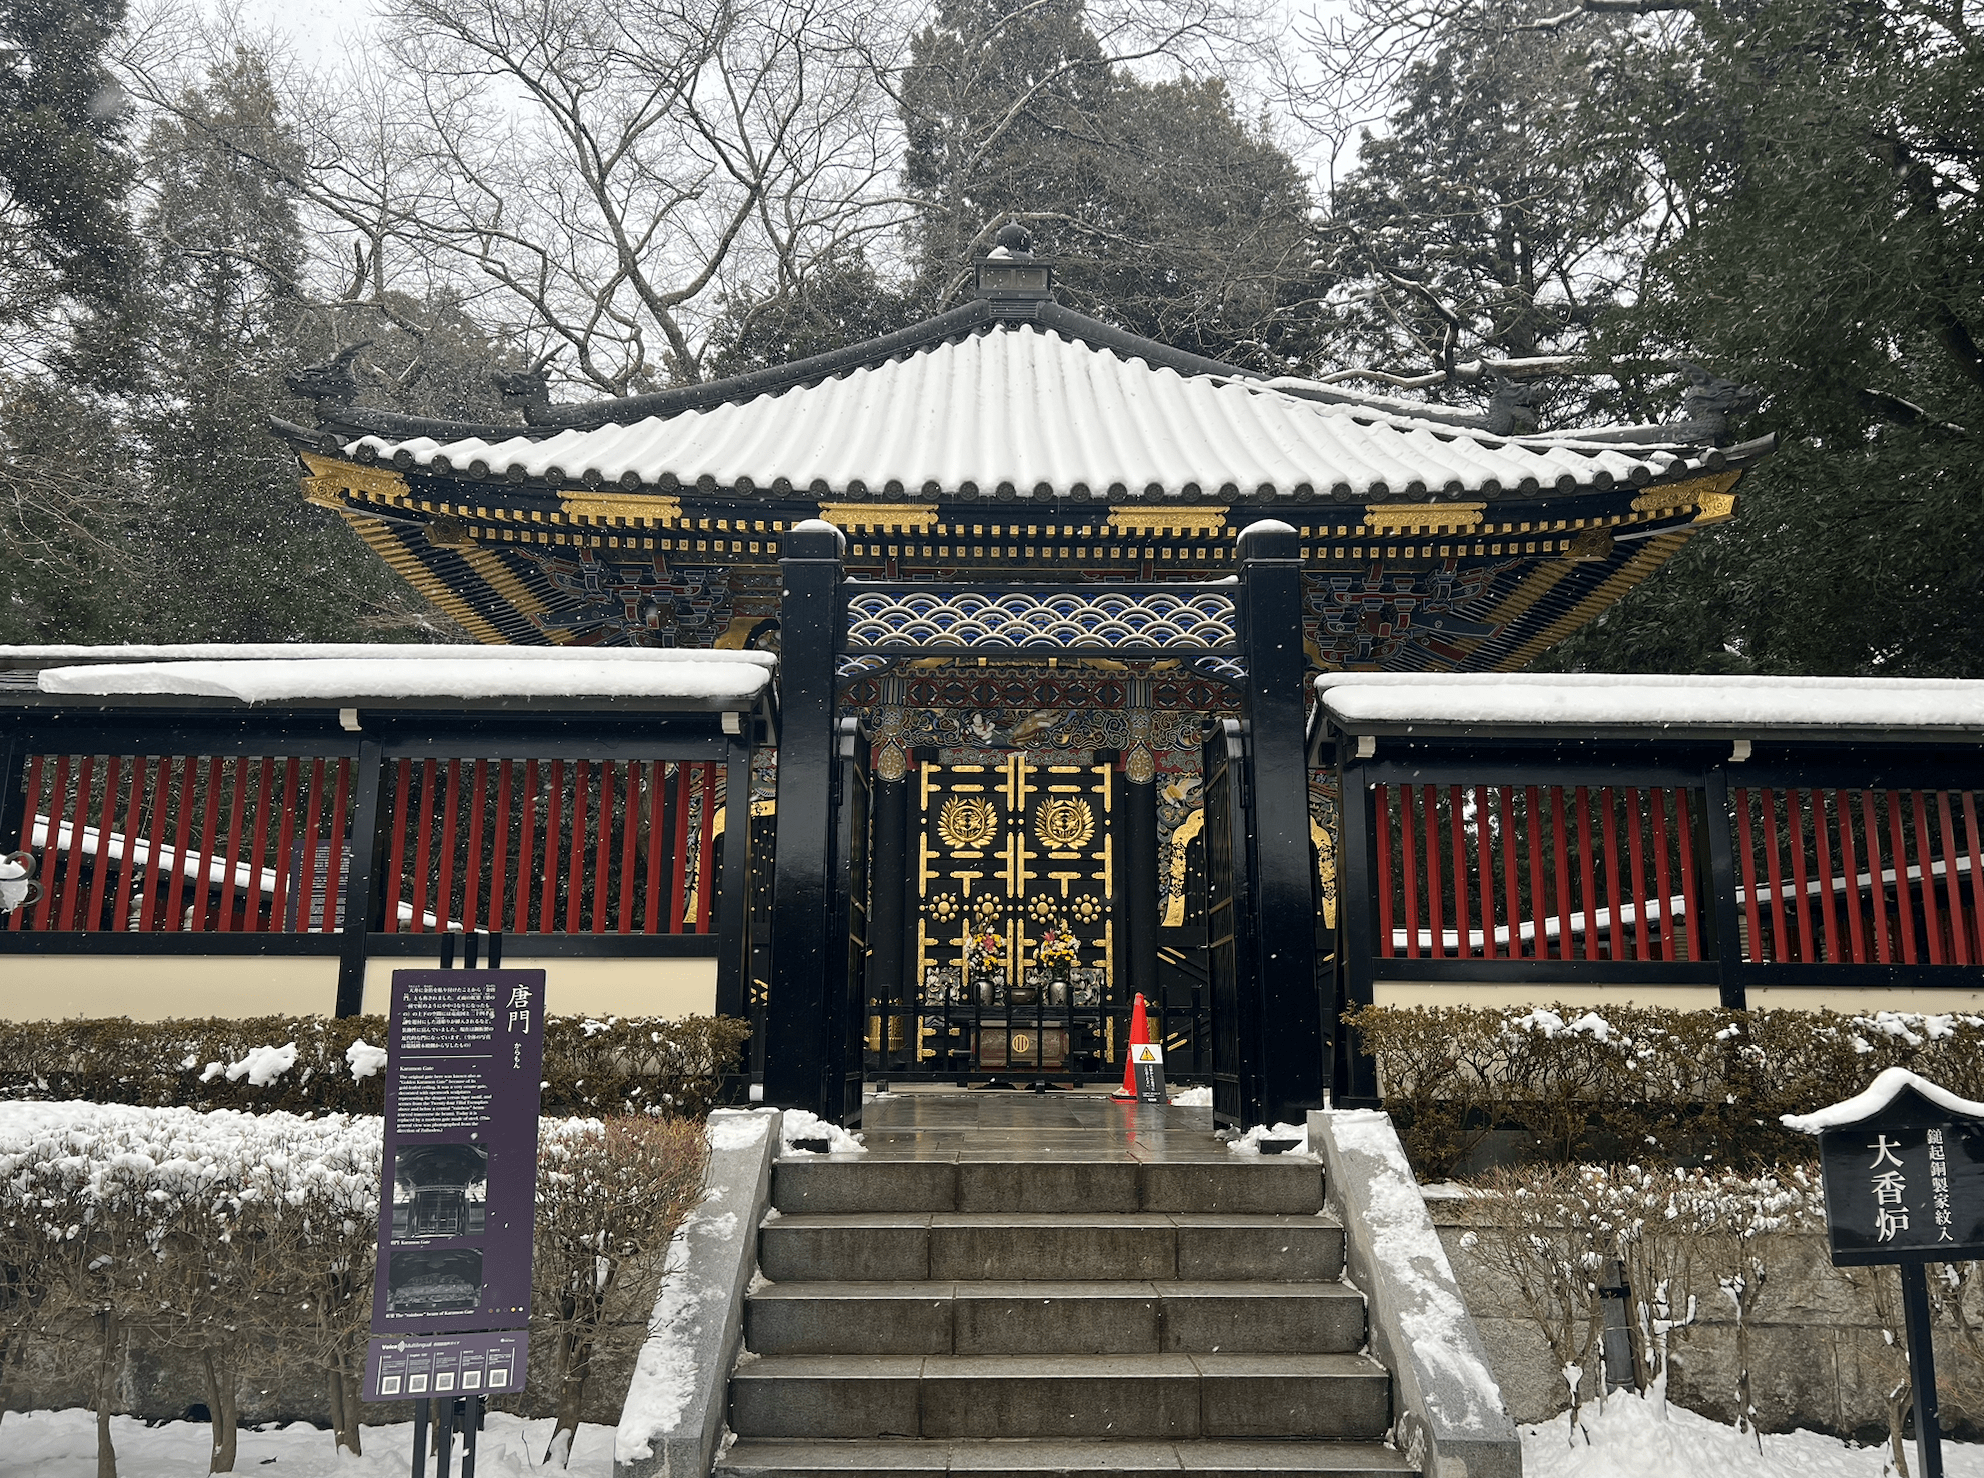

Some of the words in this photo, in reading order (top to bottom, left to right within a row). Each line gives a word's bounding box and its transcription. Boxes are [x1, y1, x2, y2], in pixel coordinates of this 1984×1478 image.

[506, 983, 533, 1035] 唐門
[513, 1043, 522, 1069] からもん
[1867, 1134, 1910, 1243] 大香炉
